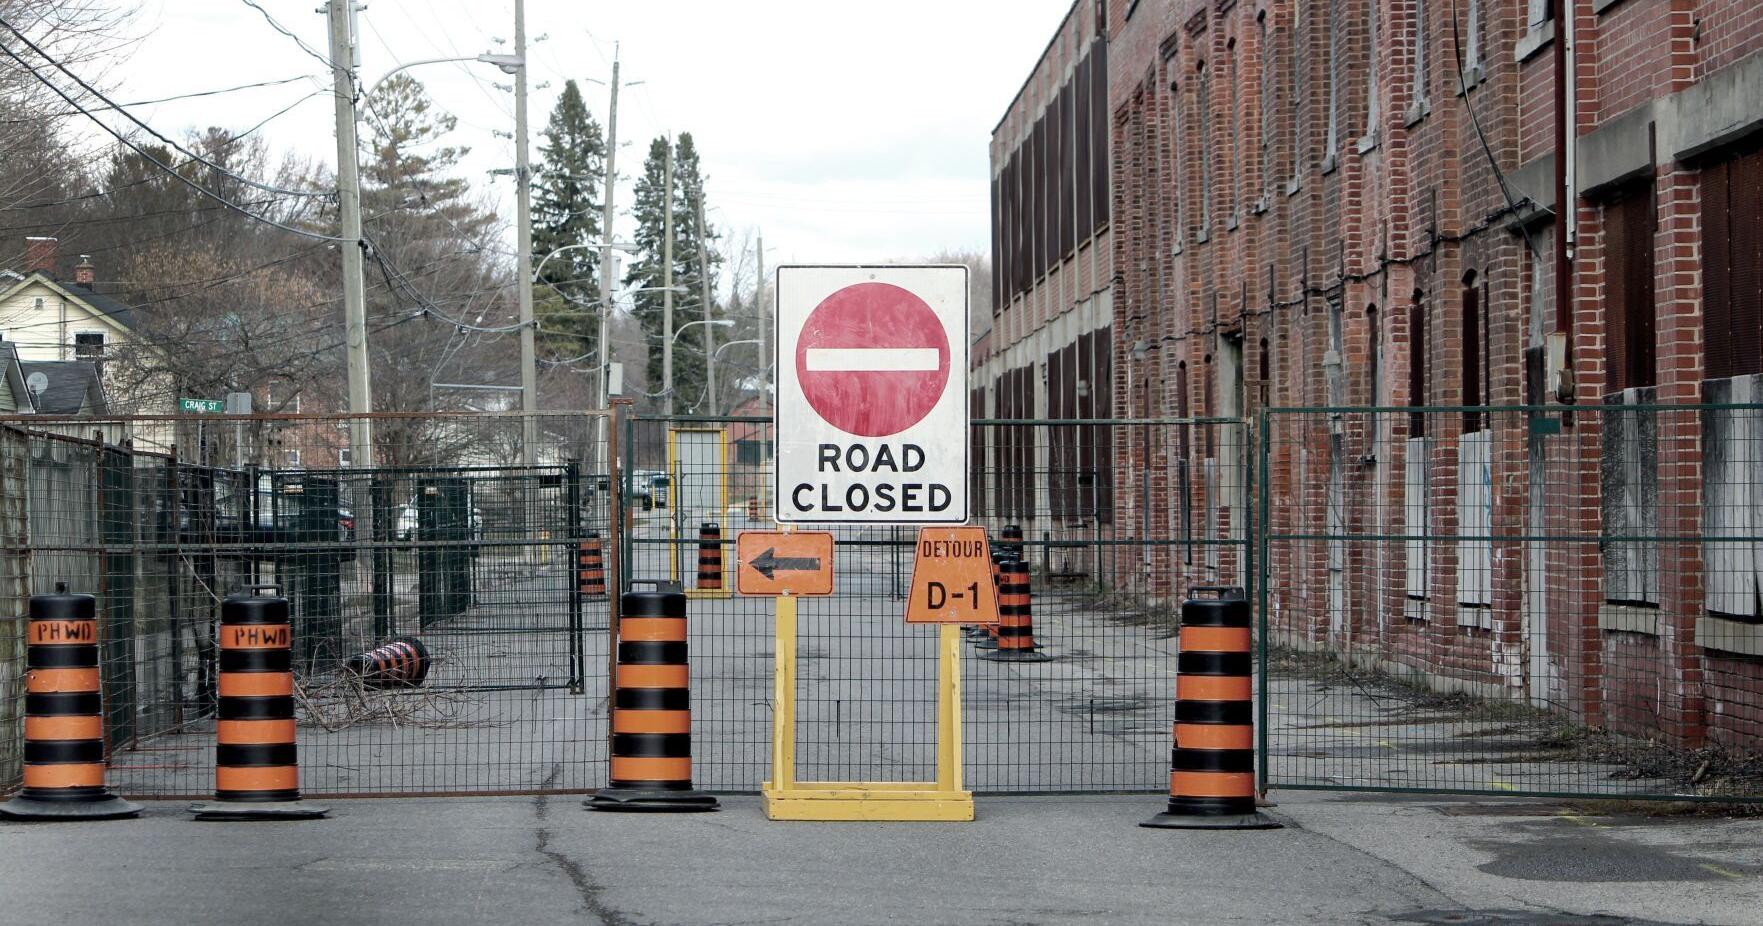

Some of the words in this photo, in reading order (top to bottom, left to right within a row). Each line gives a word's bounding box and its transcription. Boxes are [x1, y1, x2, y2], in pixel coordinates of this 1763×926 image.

[185, 401, 206, 410] CRAIG
[208, 402, 216, 410] ST
[818, 443, 926, 473] ROAD
[792, 483, 952, 512] CLOSED
[923, 540, 983, 558] DETOUR
[927, 581, 979, 610] D-1
